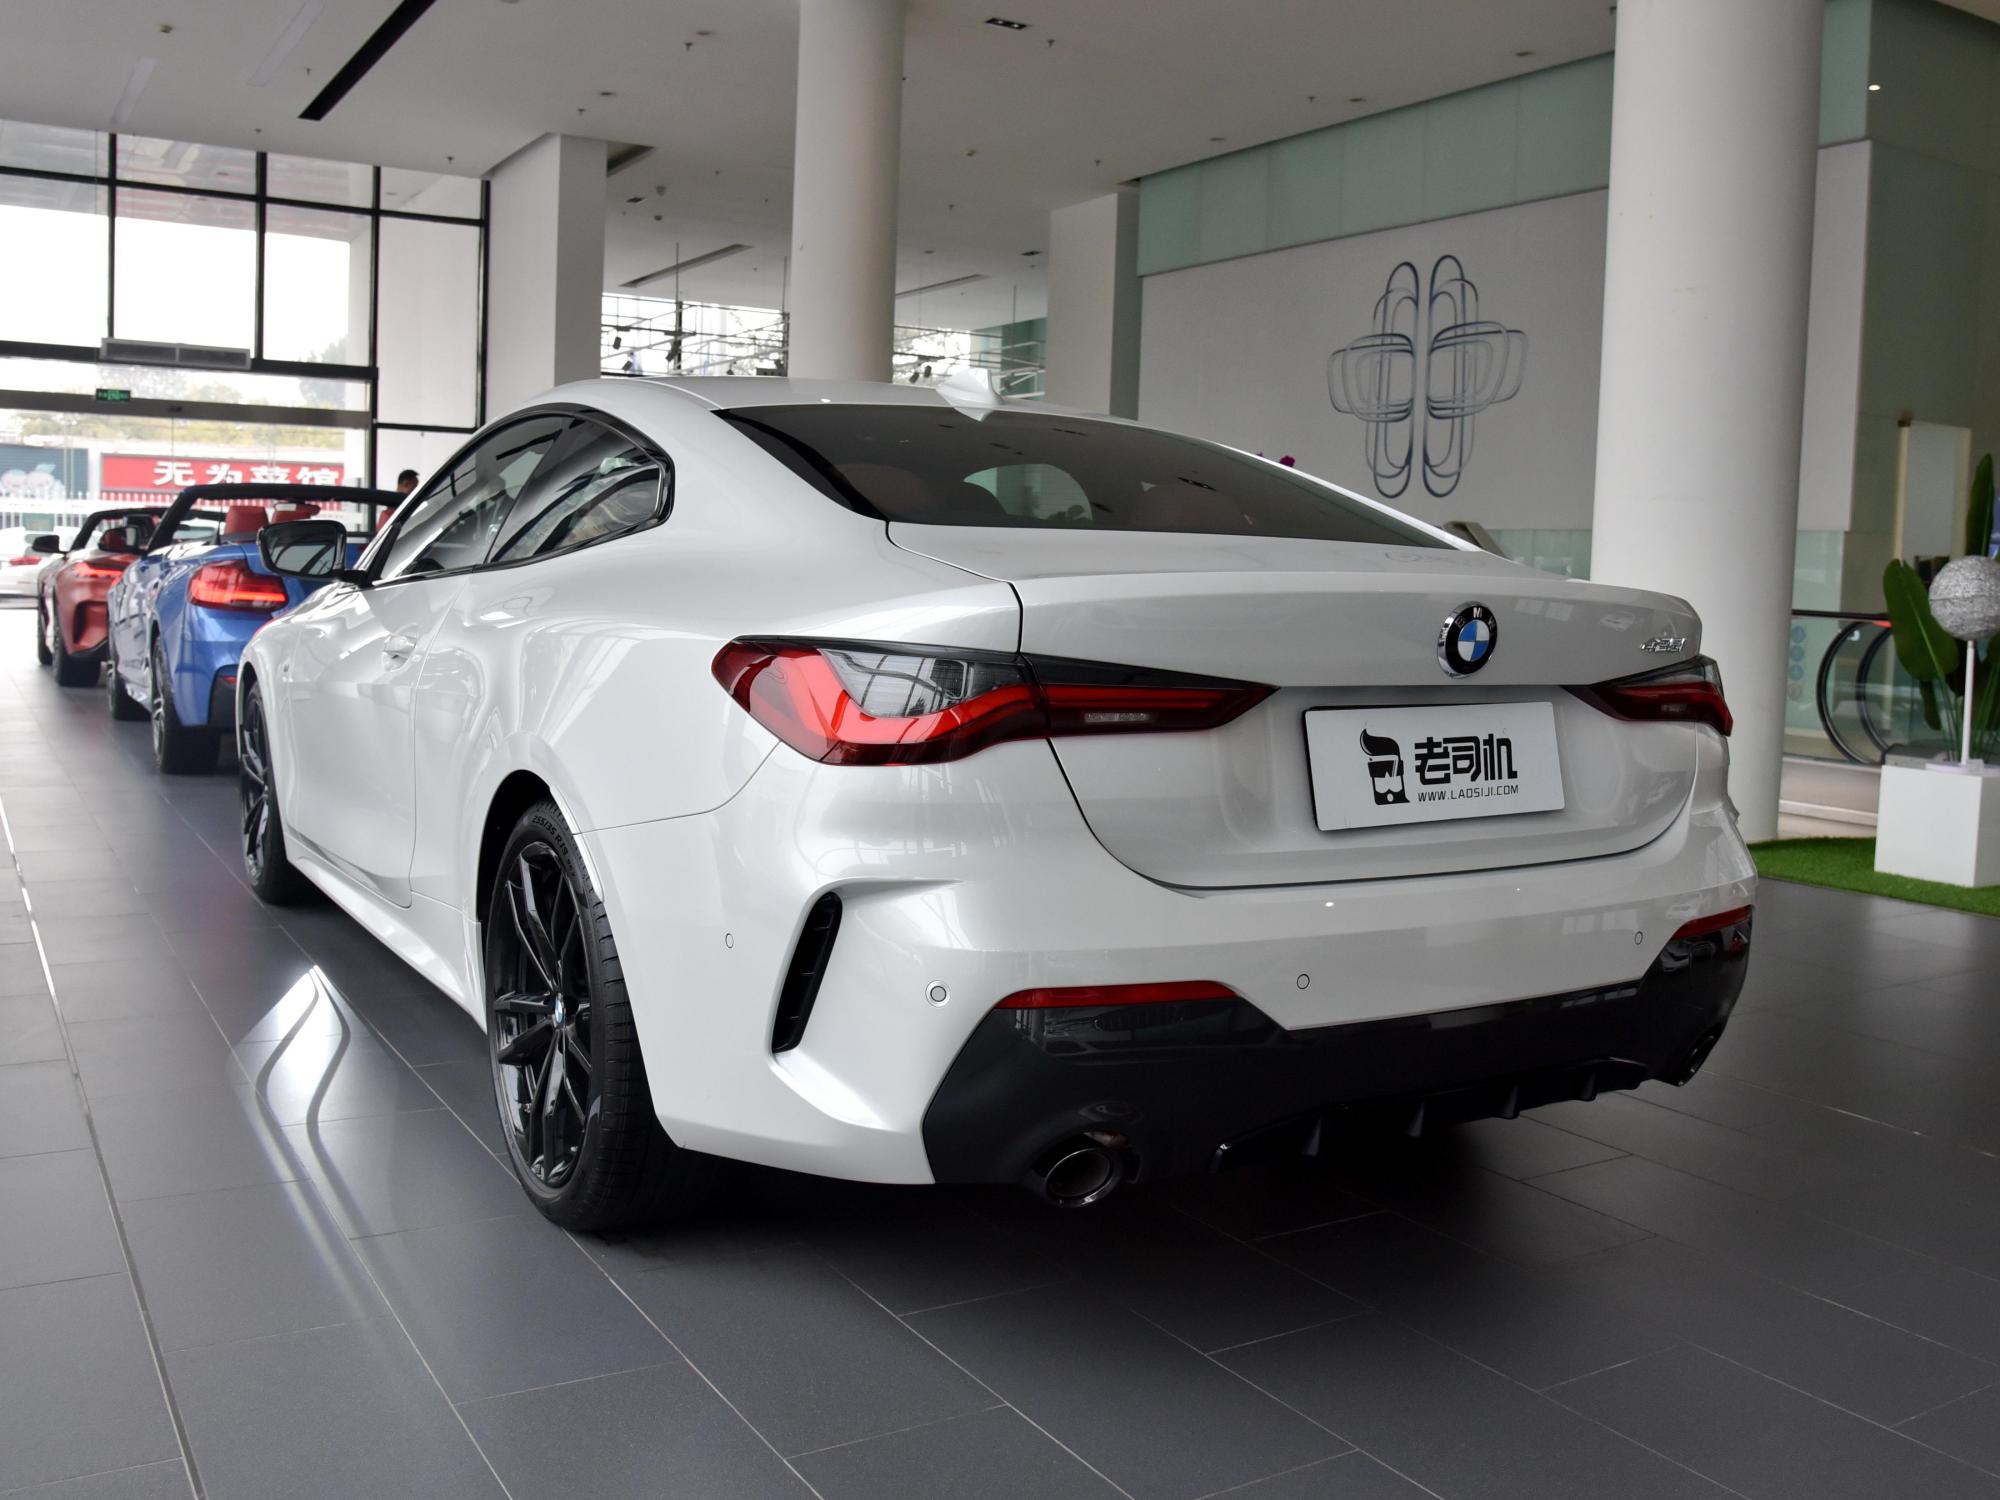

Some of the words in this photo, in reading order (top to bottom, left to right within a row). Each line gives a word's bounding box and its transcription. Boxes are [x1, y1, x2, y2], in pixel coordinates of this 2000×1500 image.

[153, 461, 340, 487] 无为菜馆
[1414, 733, 1518, 785] 老司机
[1418, 785, 1519, 802] WWW.LAOSIJI.COM
[531, 815, 557, 836] 255/35
